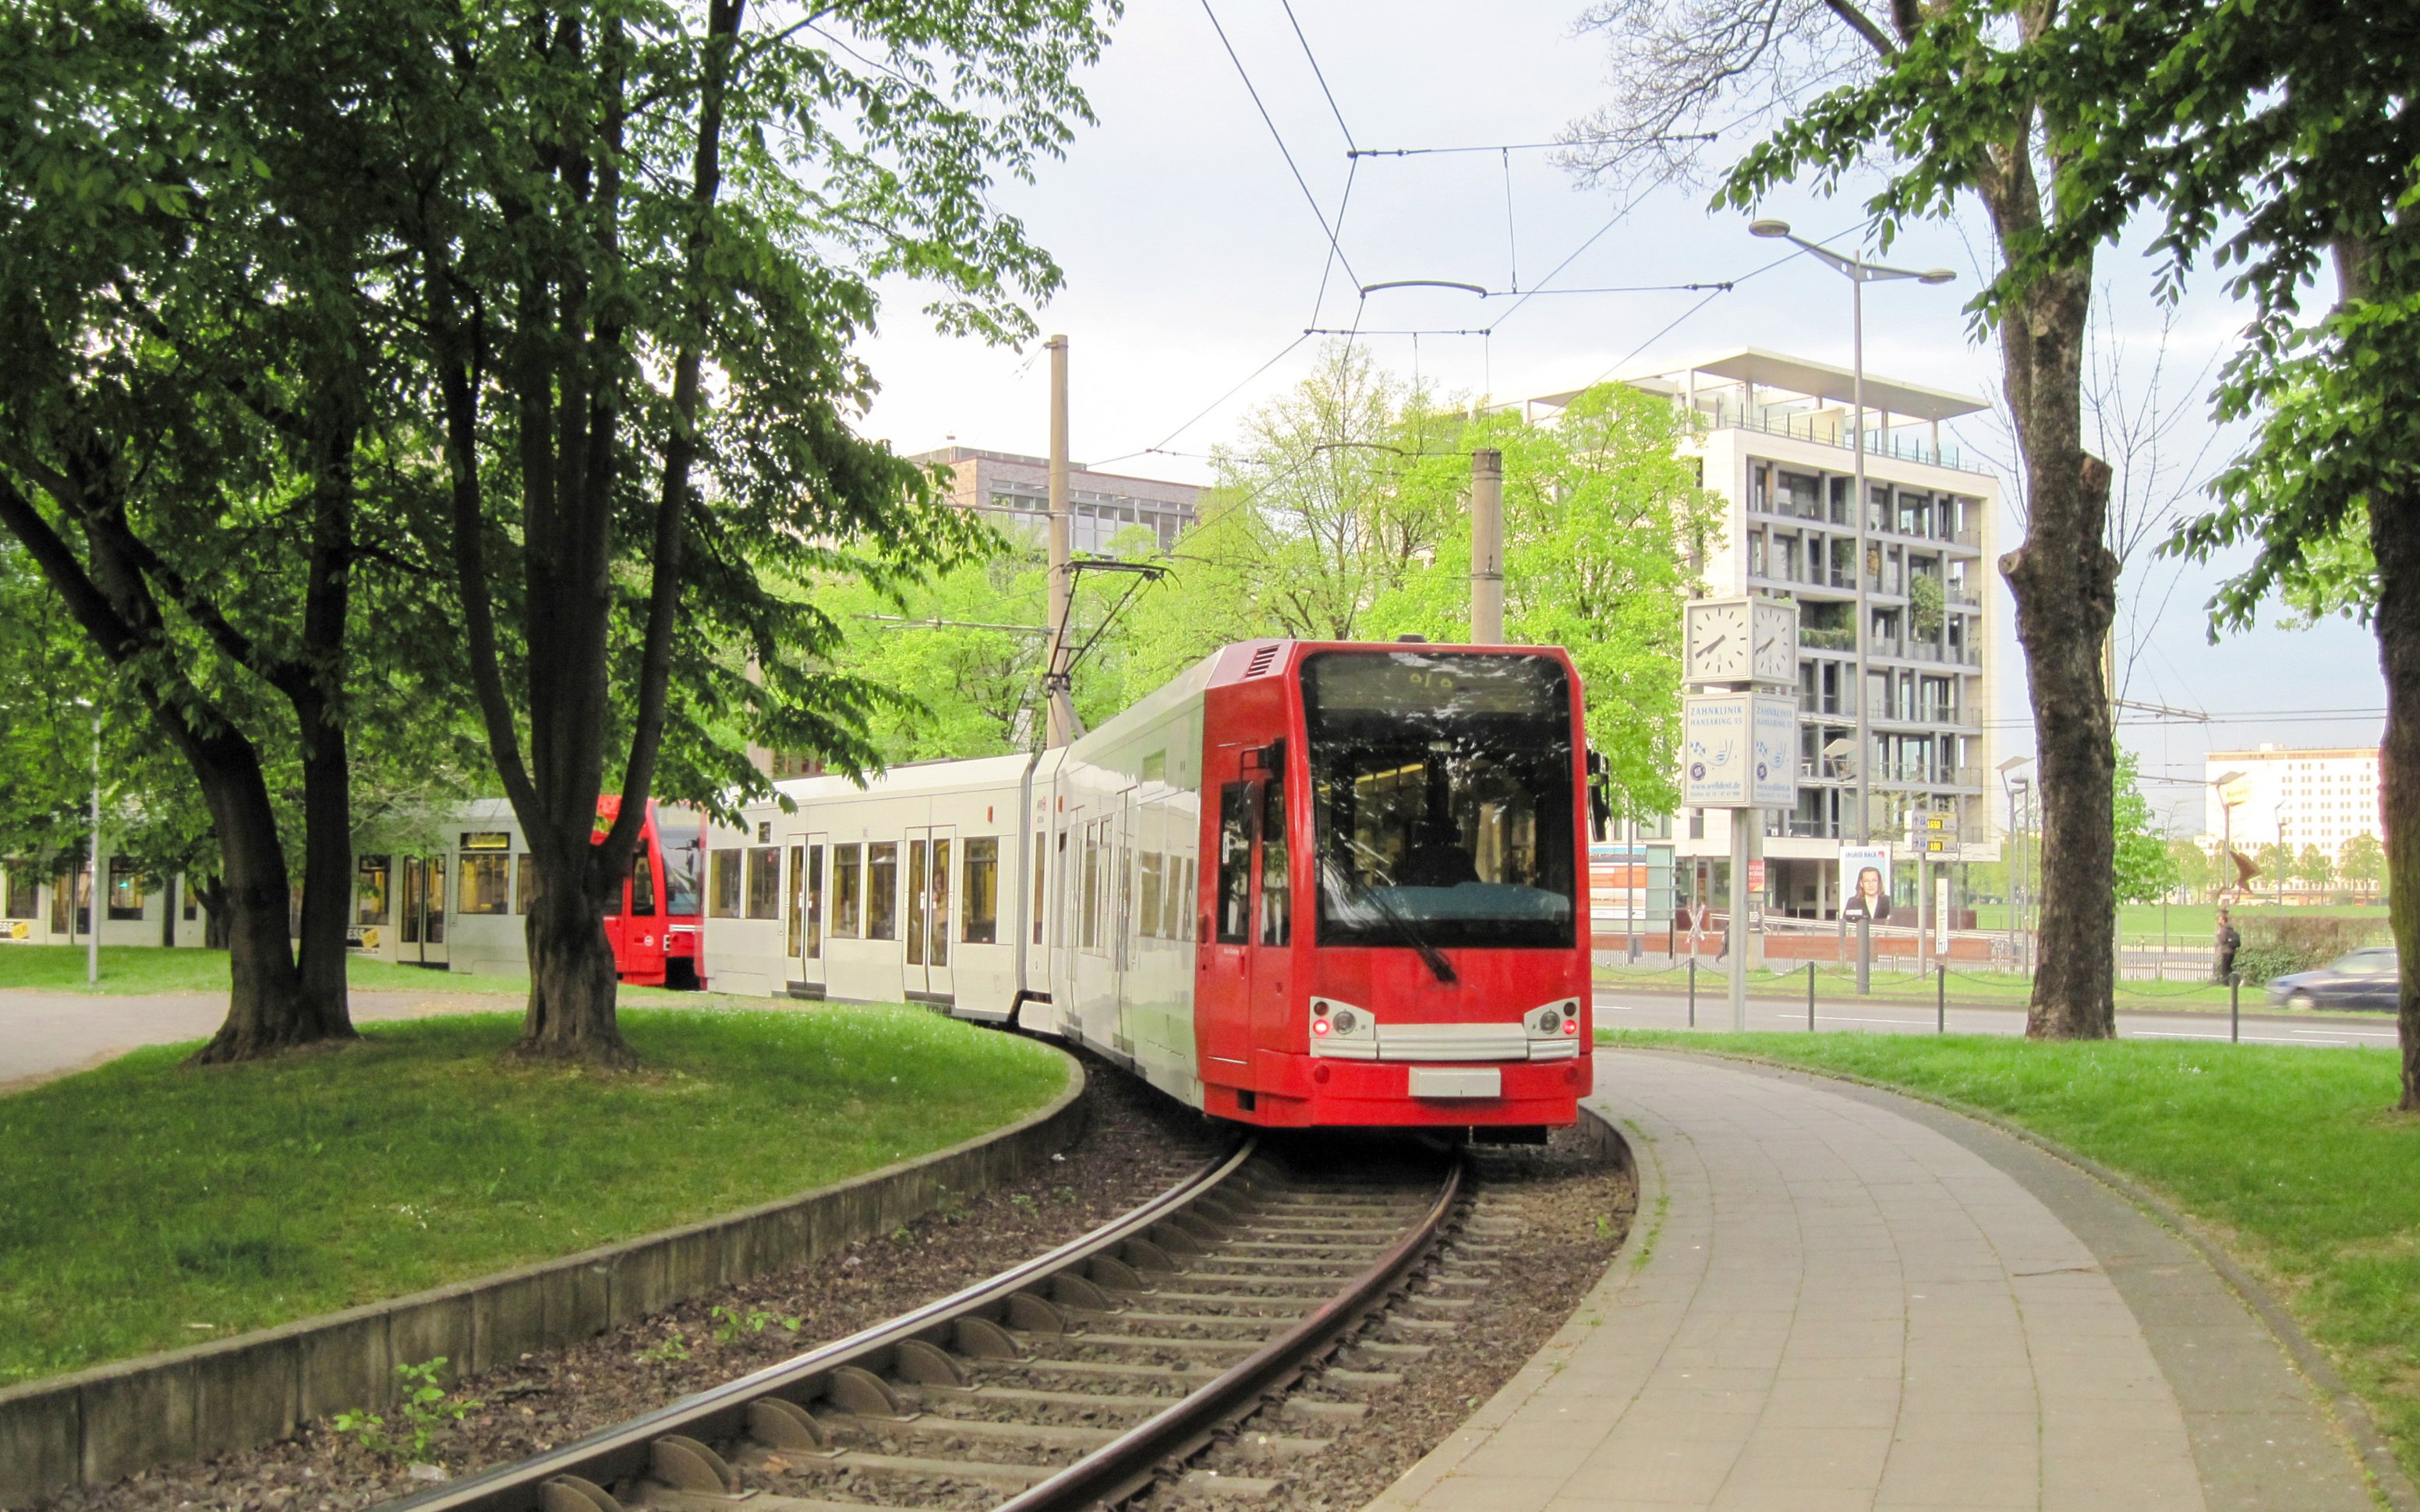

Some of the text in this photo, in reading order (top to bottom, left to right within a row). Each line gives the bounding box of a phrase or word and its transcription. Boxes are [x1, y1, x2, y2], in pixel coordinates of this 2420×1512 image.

[1690, 705, 1742, 715] ZAHNKLINIK
[1690, 717, 1732, 726] HANSARING
[1930, 842, 1941, 851] 100
